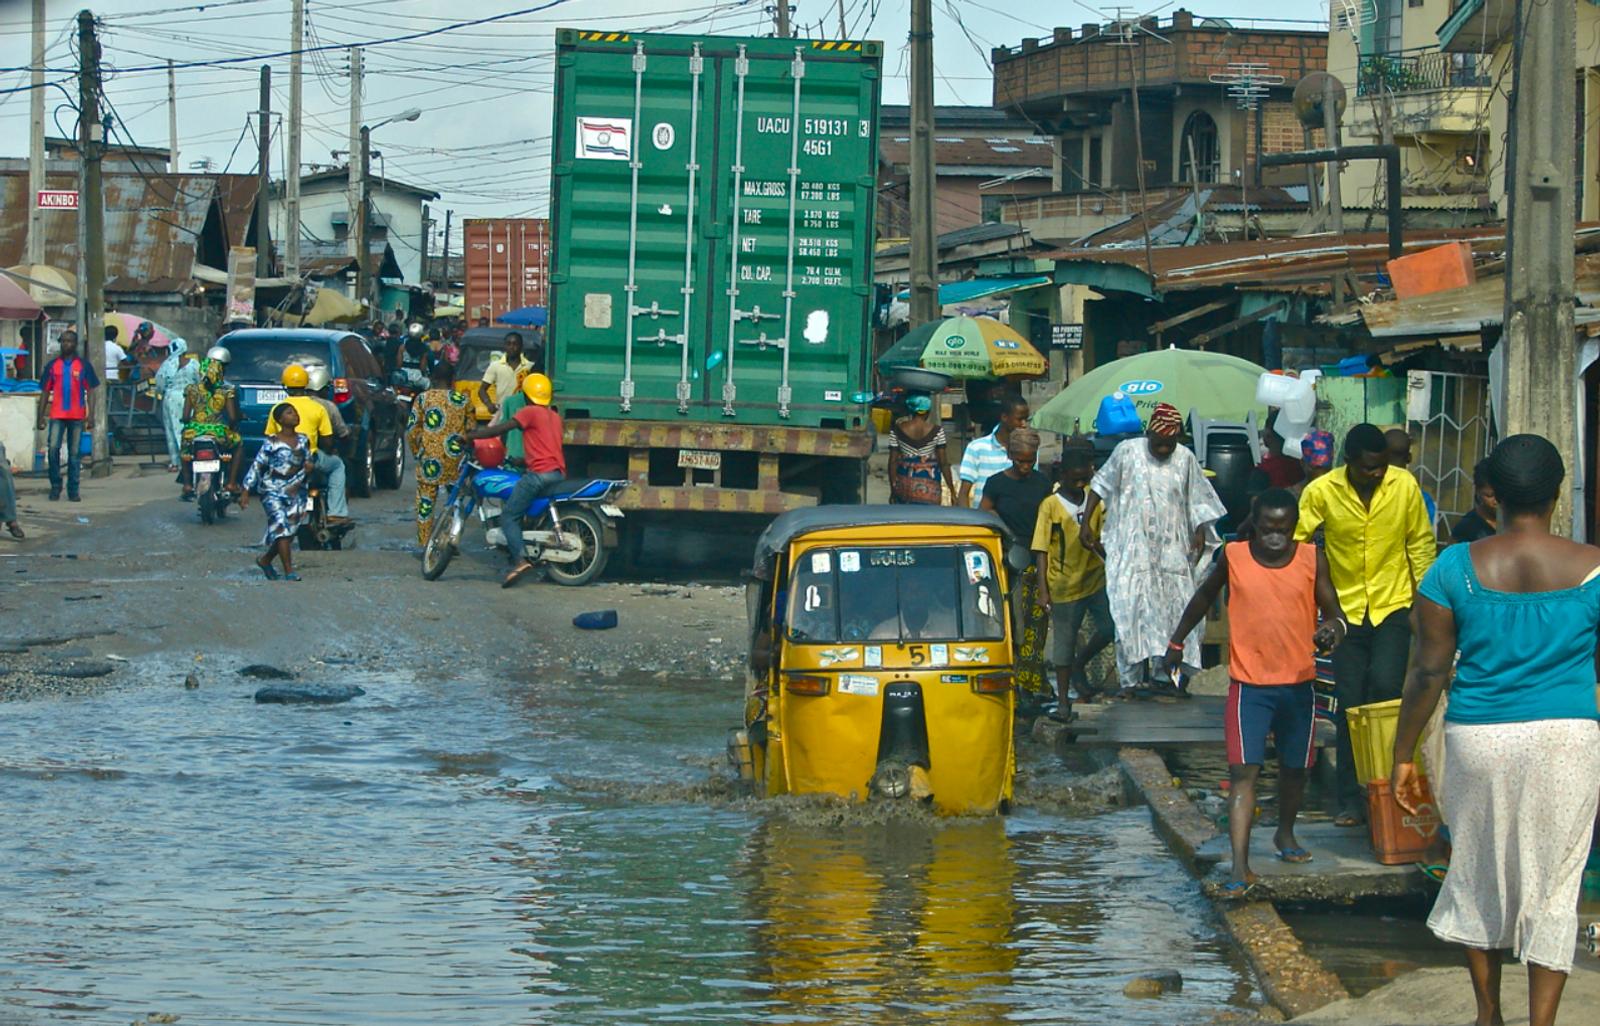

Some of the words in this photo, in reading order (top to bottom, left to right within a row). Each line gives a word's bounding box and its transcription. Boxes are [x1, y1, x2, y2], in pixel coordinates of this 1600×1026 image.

[757, 117, 790, 133] UACU
[804, 119, 848, 136] 519131
[860, 121, 868, 137] 3
[803, 140, 832, 156] 45G1
[827, 183, 840, 191] KGS
[827, 191, 840, 201] LBS
[743, 209, 762, 224] TARE
[826, 211, 840, 220] KGS
[826, 220, 839, 229] LBS
[741, 238, 757, 252] NET
[825, 239, 839, 247] KGS
[825, 248, 839, 257] LBS
[1127, 381, 1158, 393] glo
[1136, 400, 1159, 409] Prid
[909, 645, 925, 666] 5
